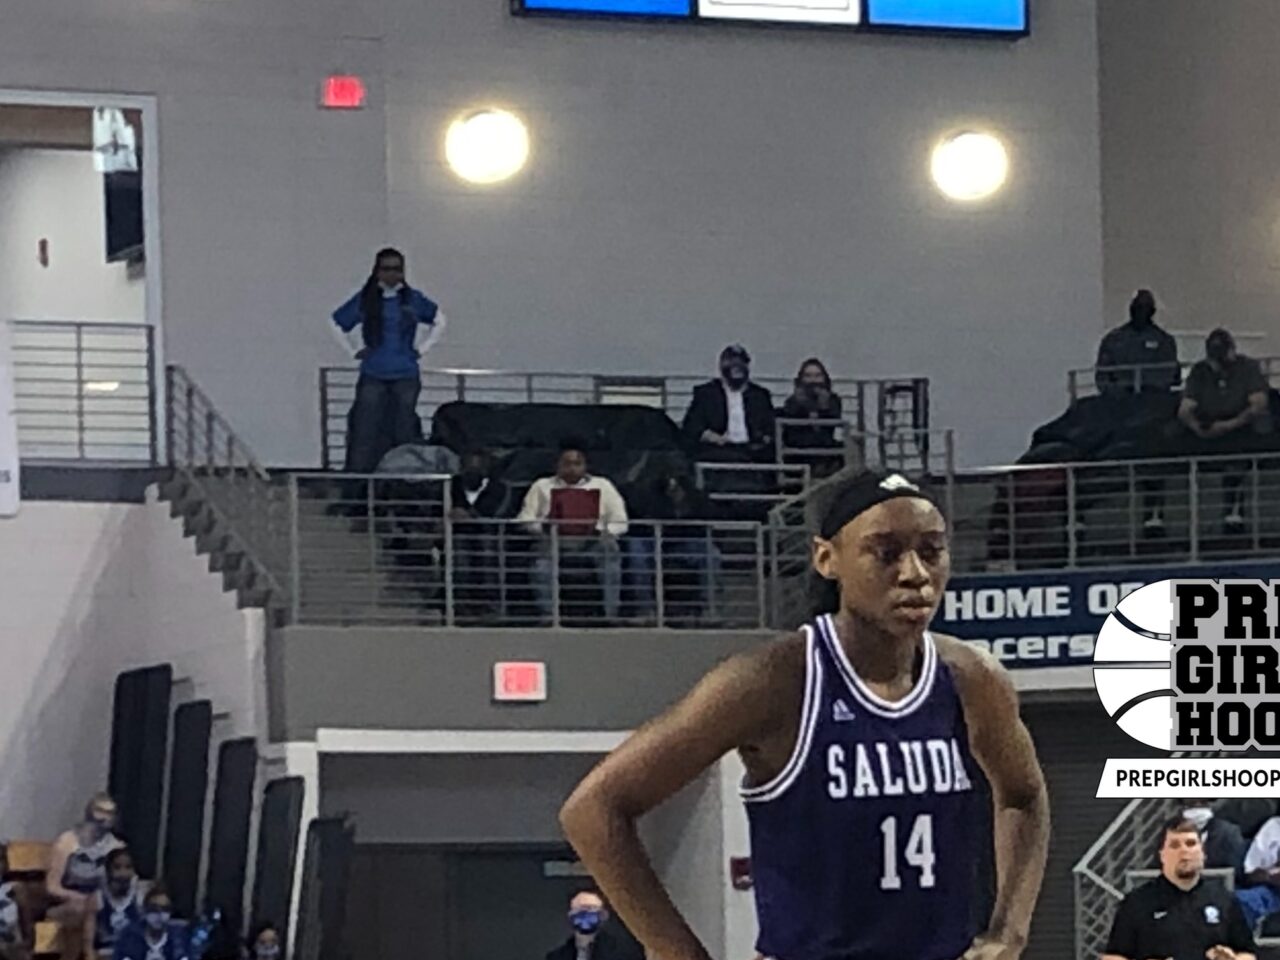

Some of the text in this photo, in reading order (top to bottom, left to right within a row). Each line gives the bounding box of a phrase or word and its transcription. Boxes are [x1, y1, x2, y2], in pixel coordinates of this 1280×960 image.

[944, 586, 1071, 621] HOME
[827, 738, 972, 799] SALUDA
[880, 814, 936, 890] 14
